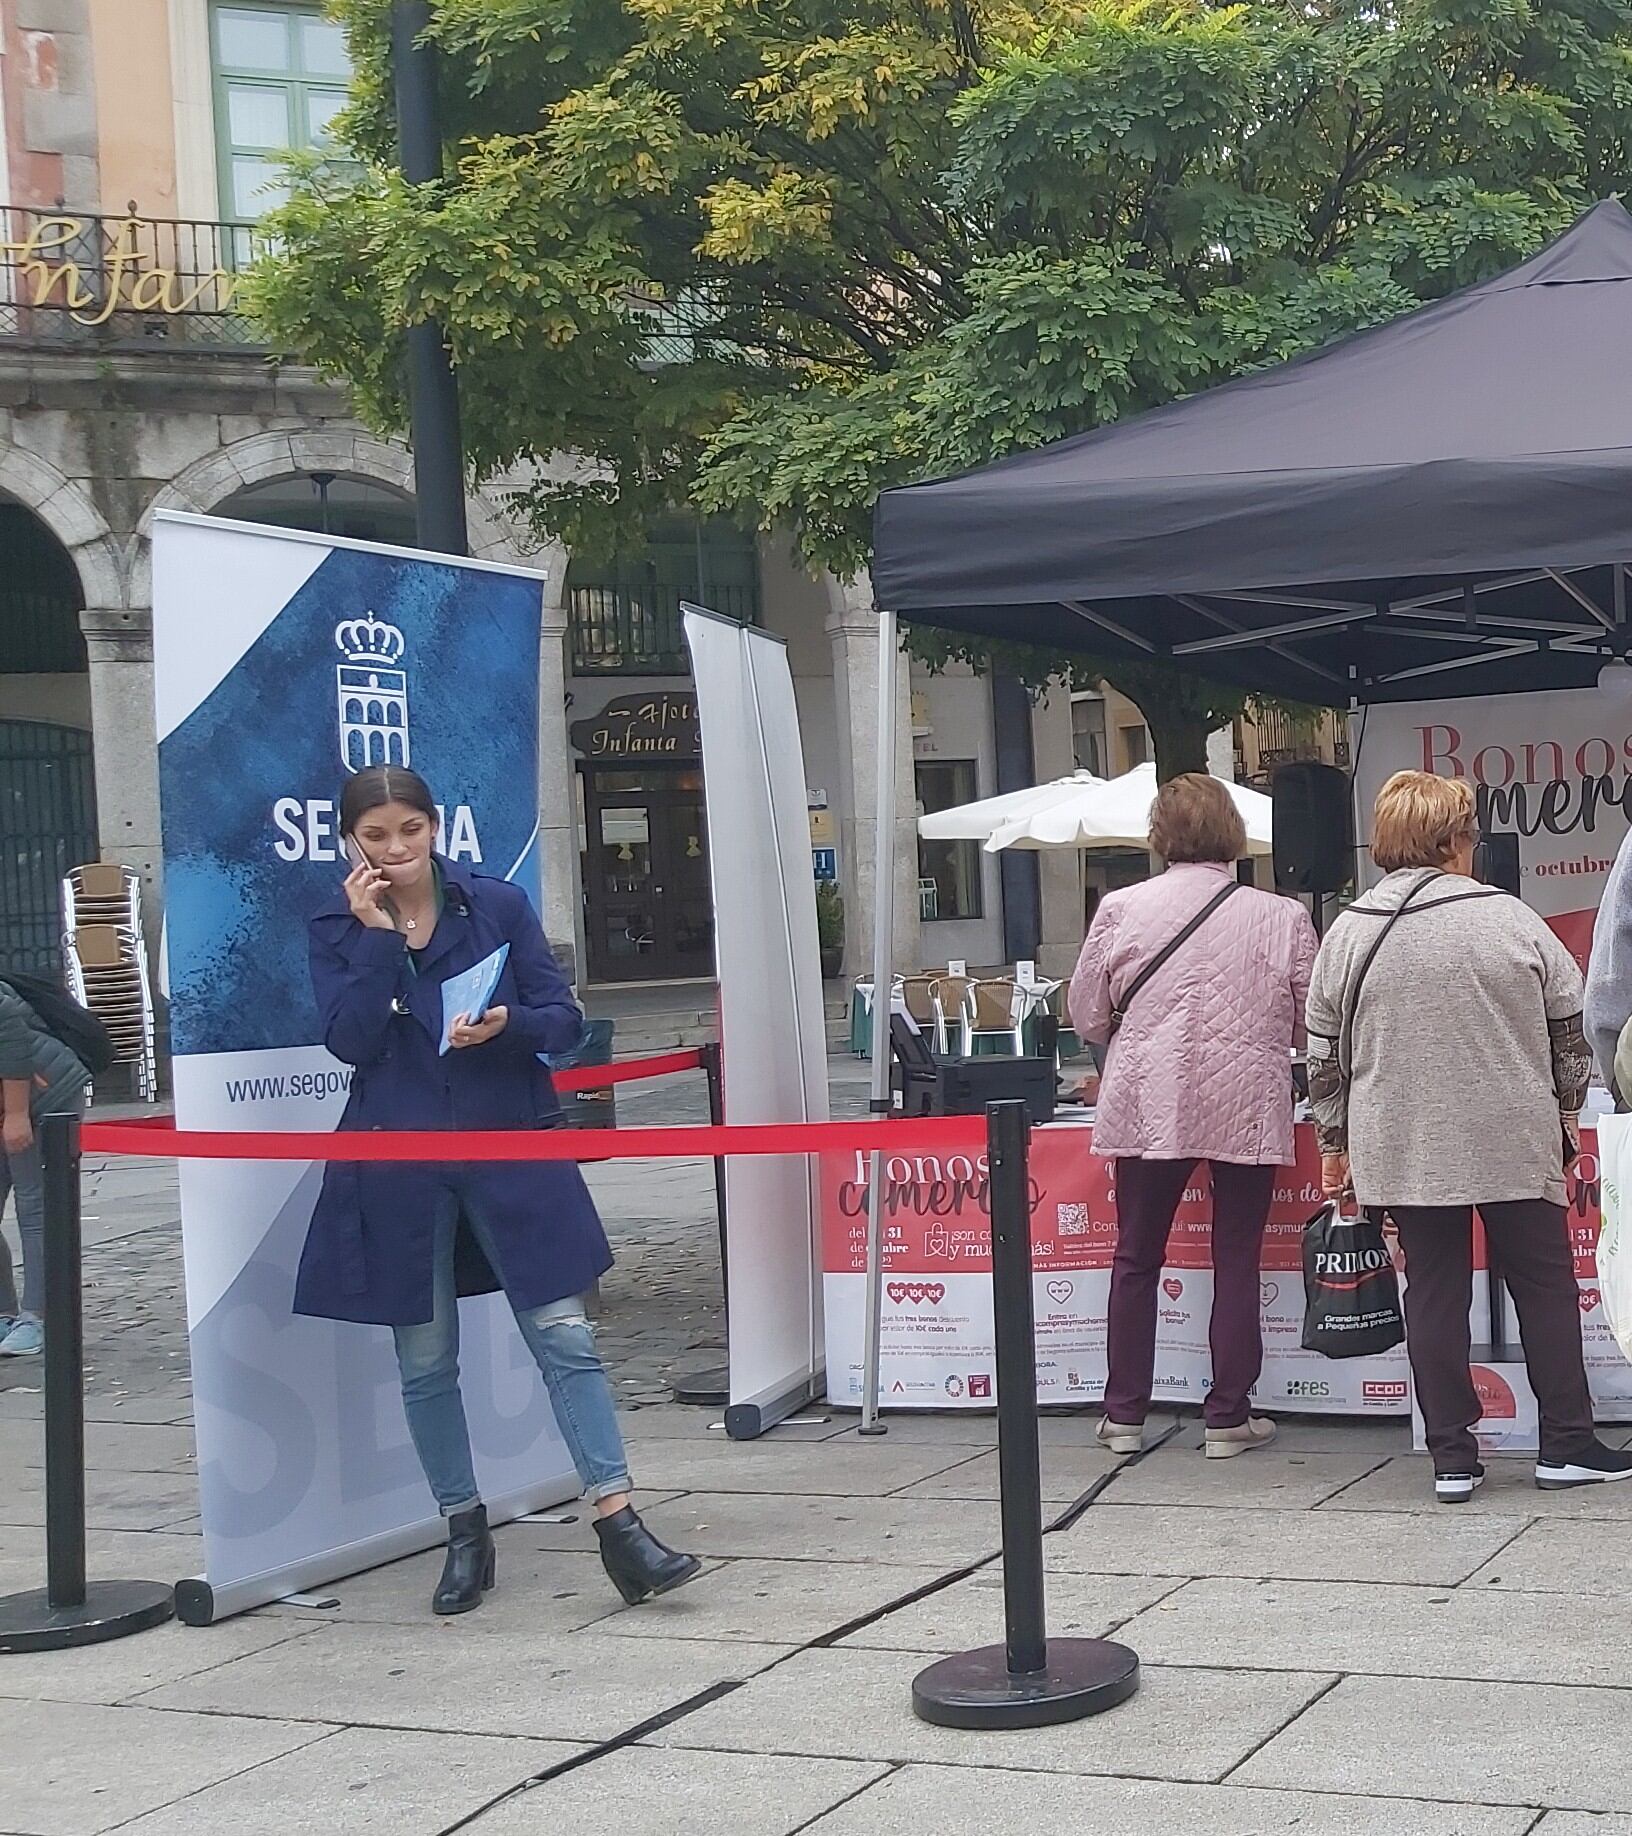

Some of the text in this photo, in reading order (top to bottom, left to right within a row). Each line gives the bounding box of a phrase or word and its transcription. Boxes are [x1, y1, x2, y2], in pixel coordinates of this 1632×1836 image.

[591, 721, 678, 757] Infanta
[273, 797, 483, 863] SEIA
[1535, 855, 1617, 877] octubr
[1182, 1188, 1206, 1202] on
[1300, 1182, 1323, 1202] de
[849, 1226, 902, 1239] del 31
[1577, 1228, 1593, 1241] 31
[850, 1242, 863, 1253] de
[949, 1244, 961, 1260] y
[1031, 1240, 1055, 1257] ás!
[851, 1257, 865, 1268] de
[890, 1288, 942, 1298] 10€ 10€ 10€
[1154, 1376, 1189, 1387] aixaBank
[1301, 1381, 1330, 1396] fes
